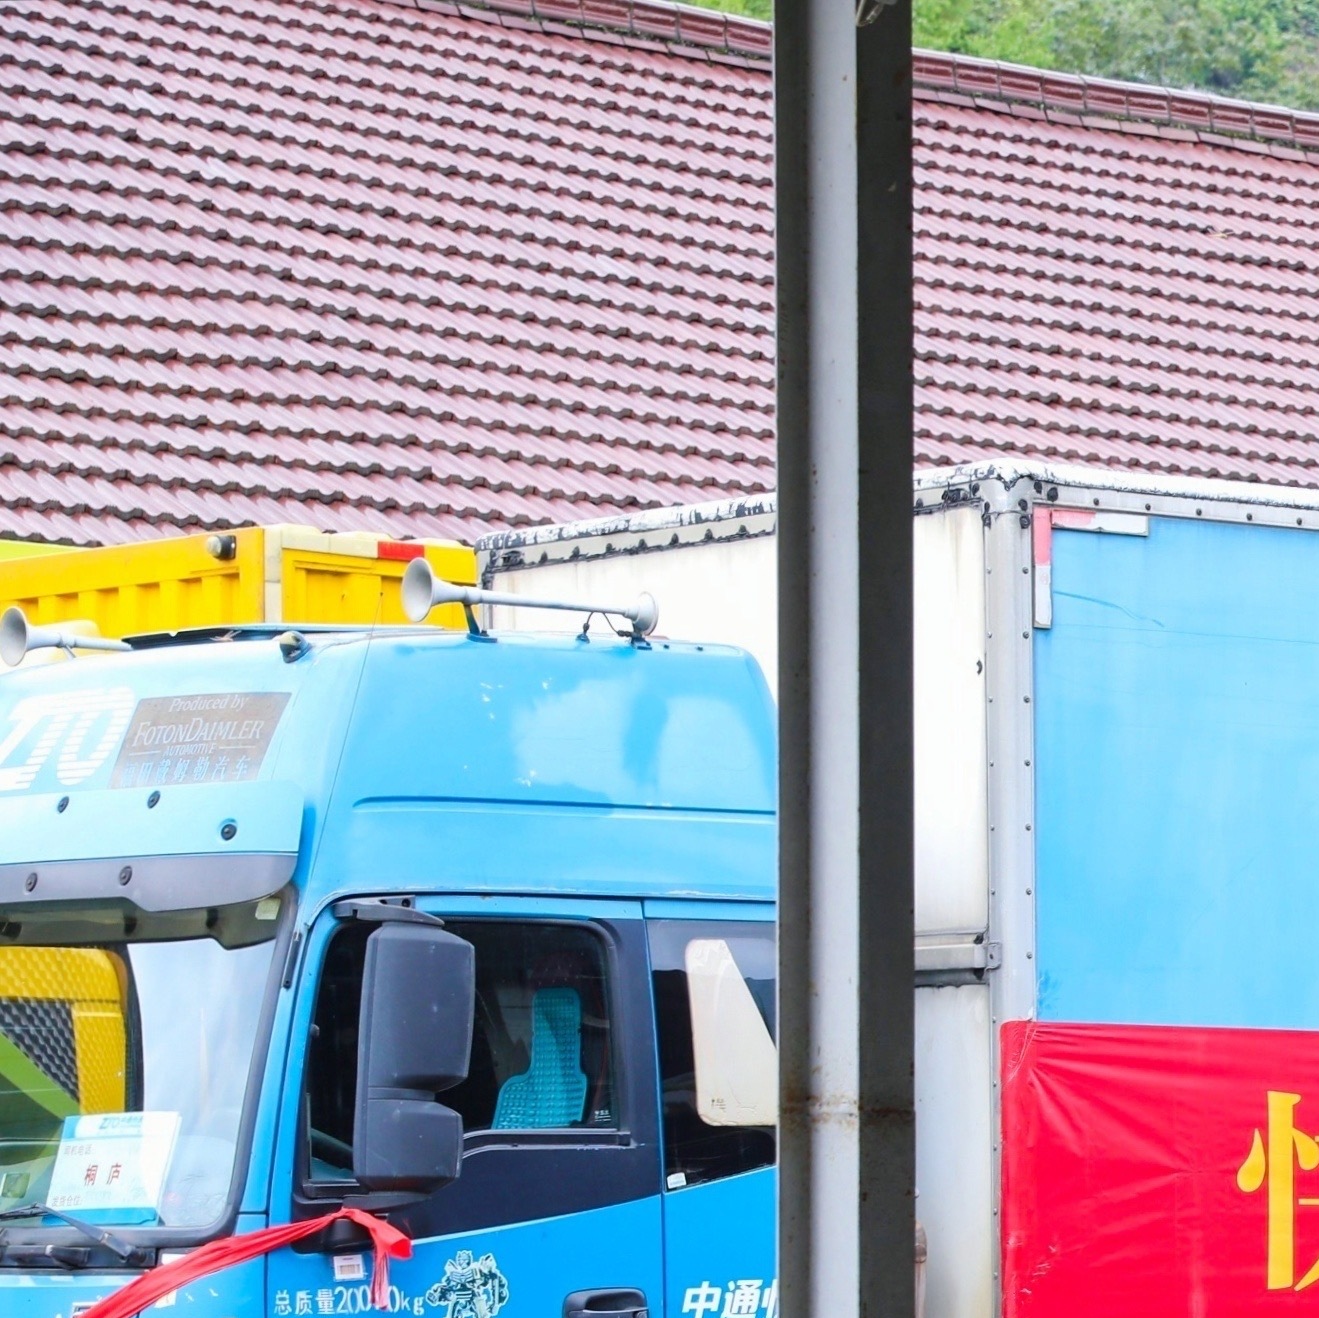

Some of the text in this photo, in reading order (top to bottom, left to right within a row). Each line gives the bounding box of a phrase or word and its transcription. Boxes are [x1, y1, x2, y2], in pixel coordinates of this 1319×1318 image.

[169, 695, 248, 713] Produced by
[0, 686, 136, 791] ZTO
